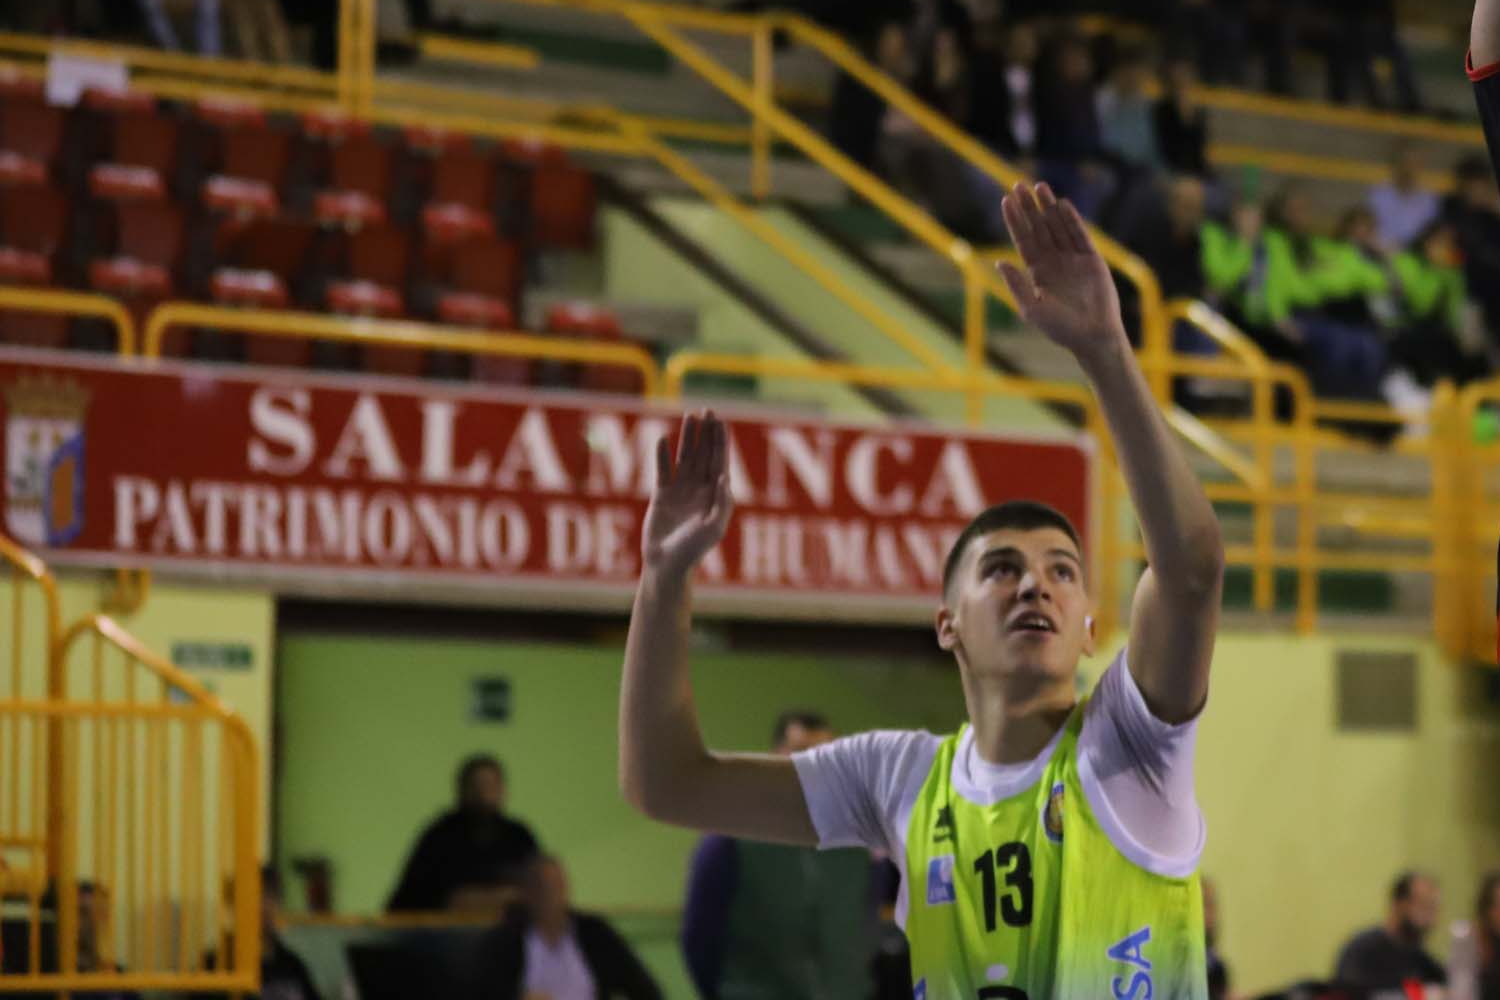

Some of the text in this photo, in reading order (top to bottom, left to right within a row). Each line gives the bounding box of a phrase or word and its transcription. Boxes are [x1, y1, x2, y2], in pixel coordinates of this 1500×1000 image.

[112, 474, 529, 568] PATRIMONIO
[545, 504, 637, 576] DE
[973, 841, 1034, 933] 13
